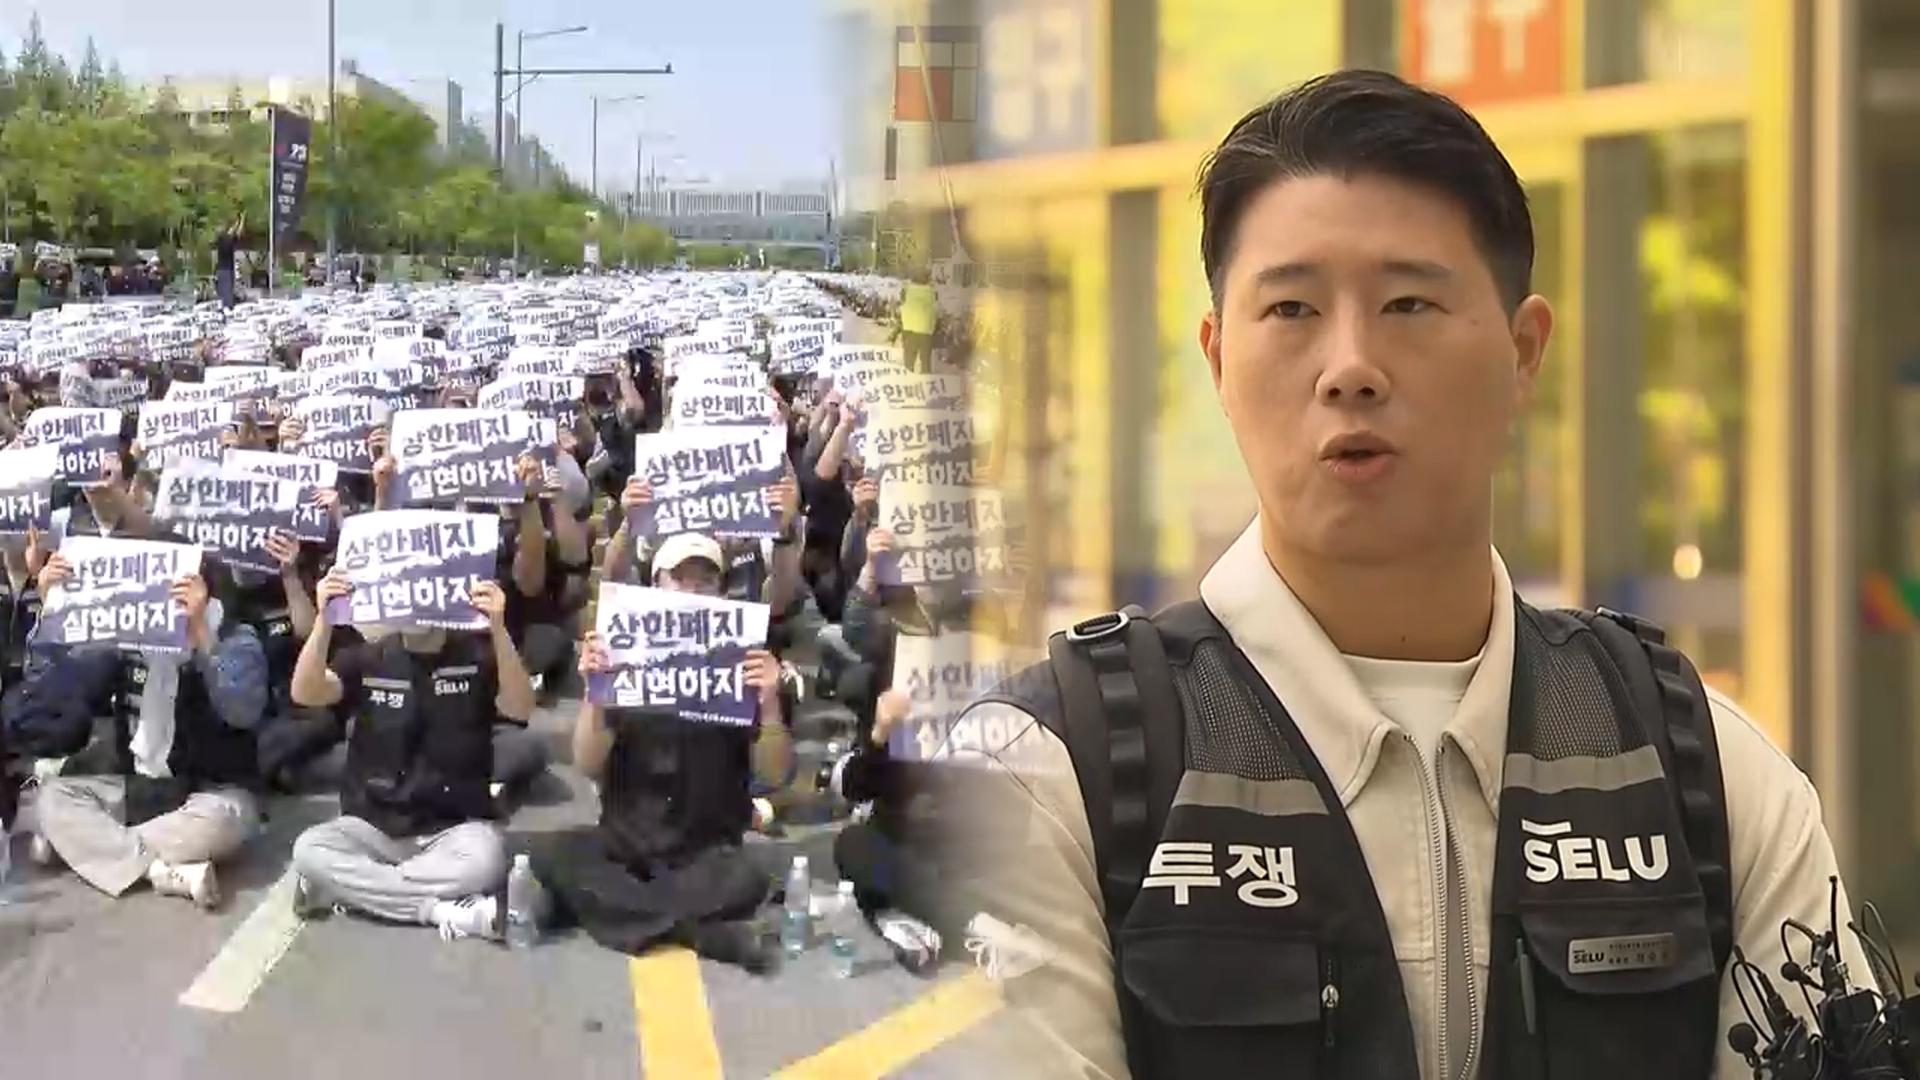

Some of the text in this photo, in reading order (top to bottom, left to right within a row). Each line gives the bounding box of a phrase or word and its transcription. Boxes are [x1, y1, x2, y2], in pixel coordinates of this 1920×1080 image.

[143, 403, 218, 439] 상한폐지
[682, 395, 765, 417] 상한폐지
[24, 412, 105, 446] 상한폐지
[402, 414, 510, 456] 상한폐지
[874, 417, 974, 454] 상한폐지
[408, 456, 517, 499] 실현하자
[645, 438, 762, 487] 상한폐지
[169, 477, 279, 508] 상한폐지
[654, 487, 774, 534] 실현하자
[345, 518, 476, 570] 상한폐지
[62, 549, 178, 592] 상한폐지
[351, 575, 480, 622] 실현하자
[62, 599, 181, 644] 실현하자
[607, 608, 744, 650] 상한폐지
[613, 662, 746, 707] 실현하자
[1521, 819, 1670, 883] SELU
[1142, 842, 1299, 908] 투쟁
[1573, 949, 1605, 964] SELU
